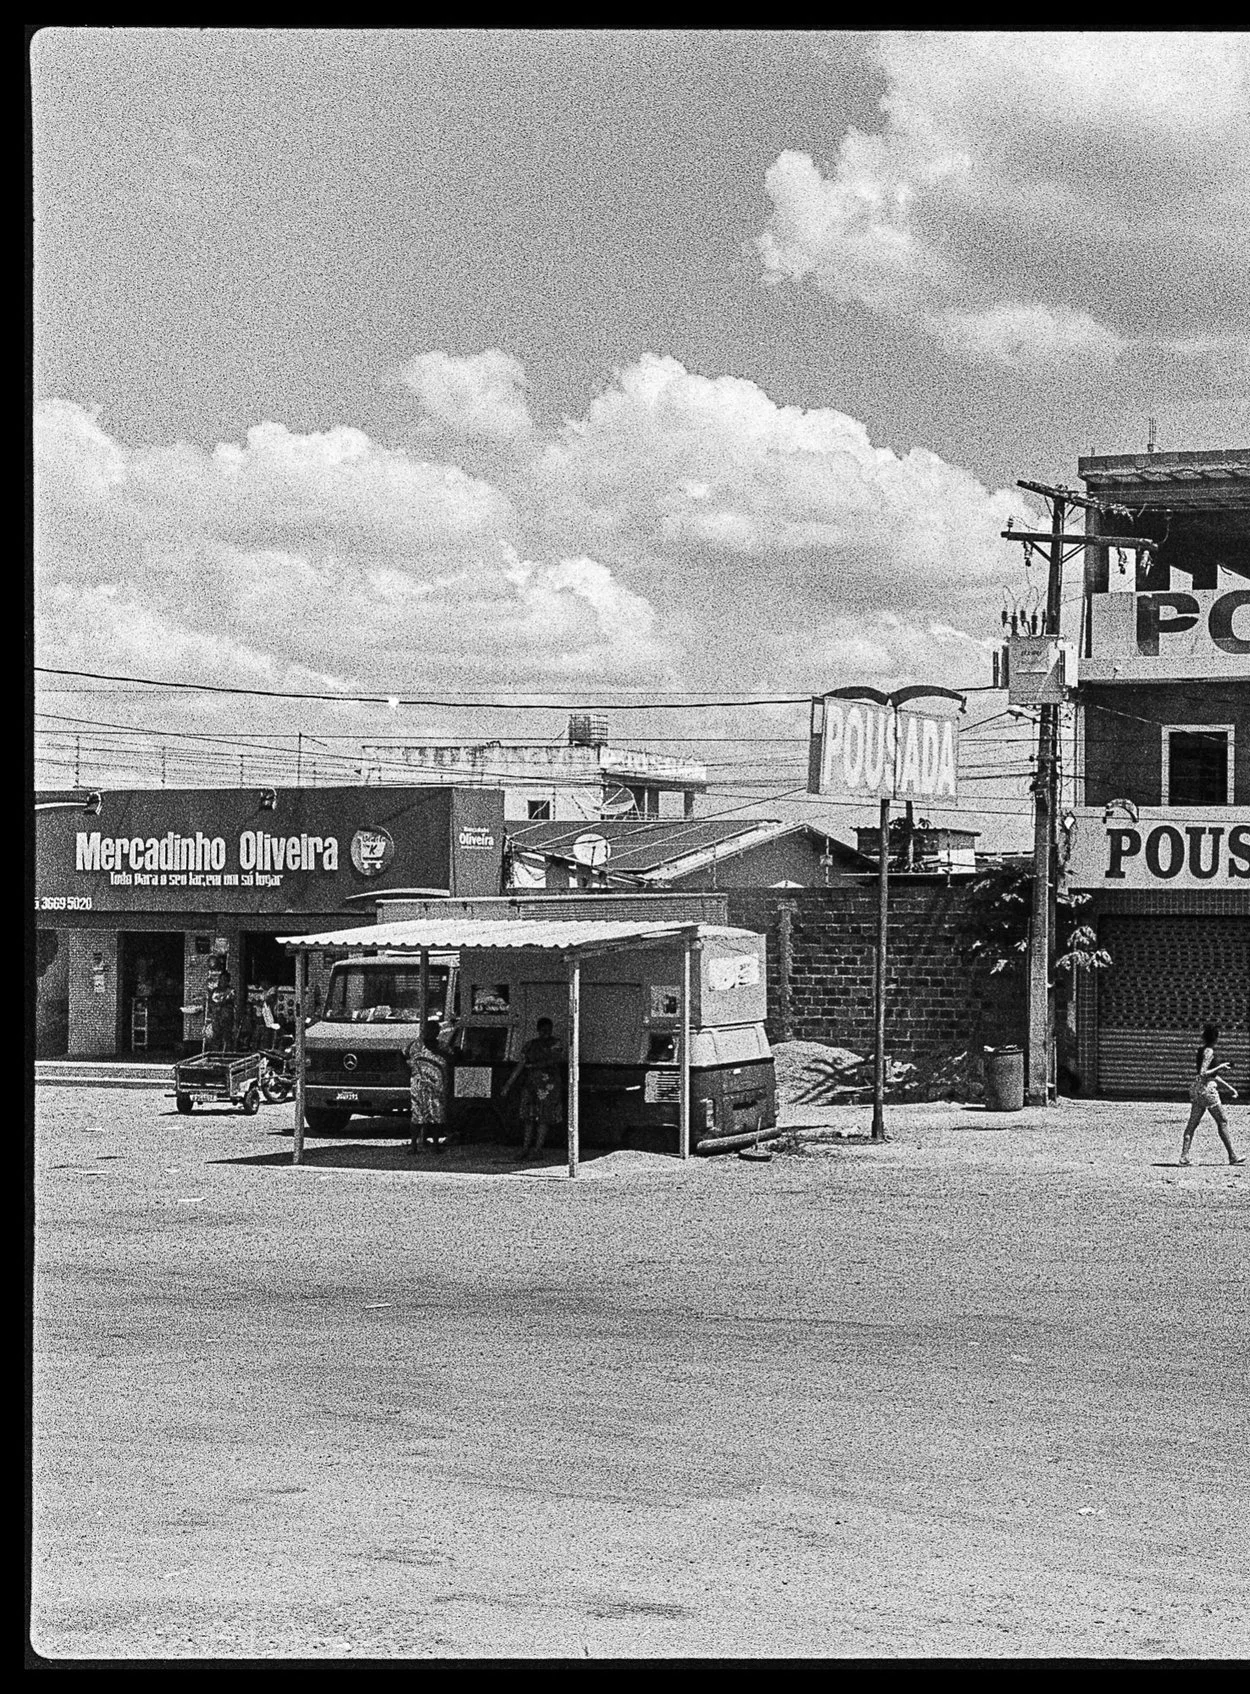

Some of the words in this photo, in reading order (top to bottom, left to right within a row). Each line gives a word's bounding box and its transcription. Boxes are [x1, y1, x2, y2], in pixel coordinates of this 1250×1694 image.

[822, 704, 957, 796] POUSADA
[75, 831, 226, 871] Mercadinho
[239, 830, 339, 871] Oliveira
[459, 832, 495, 846] Oliveira
[41, 896, 66, 910] 3669
[67, 896, 92, 910] 5020
